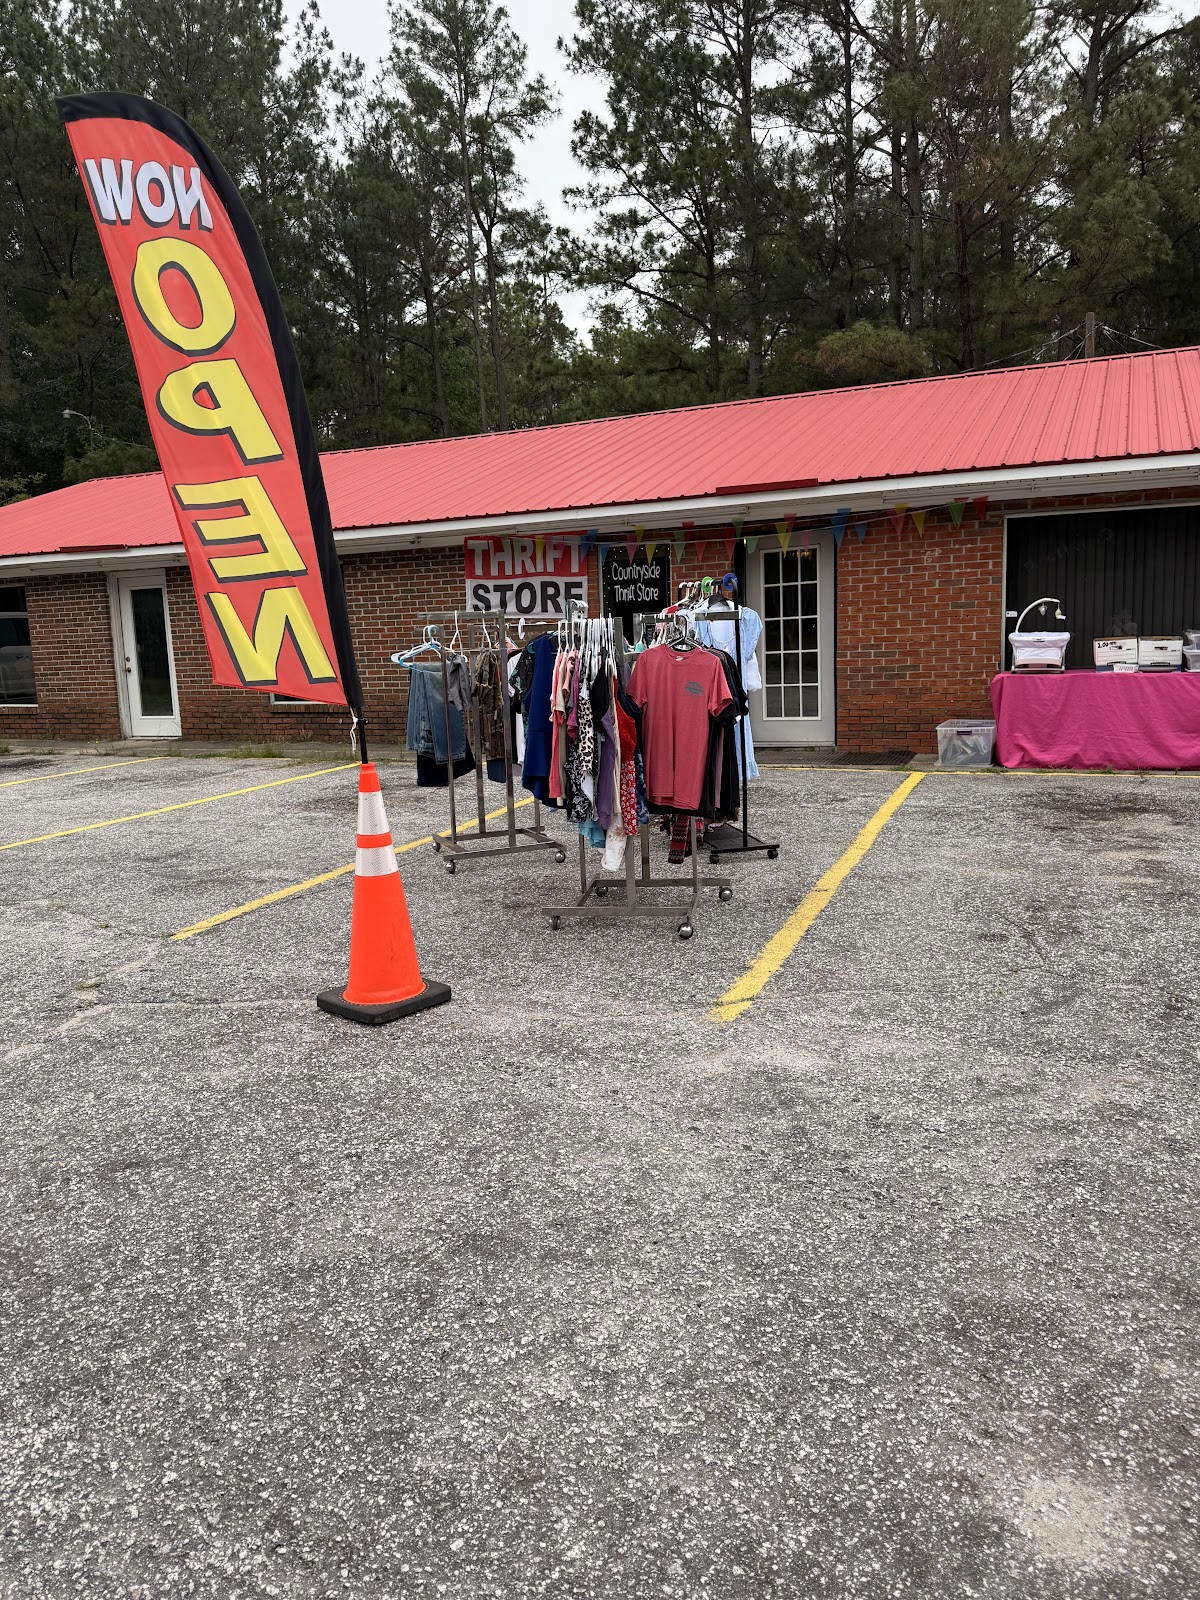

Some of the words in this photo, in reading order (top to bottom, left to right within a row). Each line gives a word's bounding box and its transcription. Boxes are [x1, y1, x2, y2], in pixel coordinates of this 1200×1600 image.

[466, 535, 581, 576] THRIFT
[611, 561, 661, 583] Countryside
[472, 581, 583, 614] STORE
[613, 584, 636, 602] Thrift
[636, 582, 659, 601] Store
